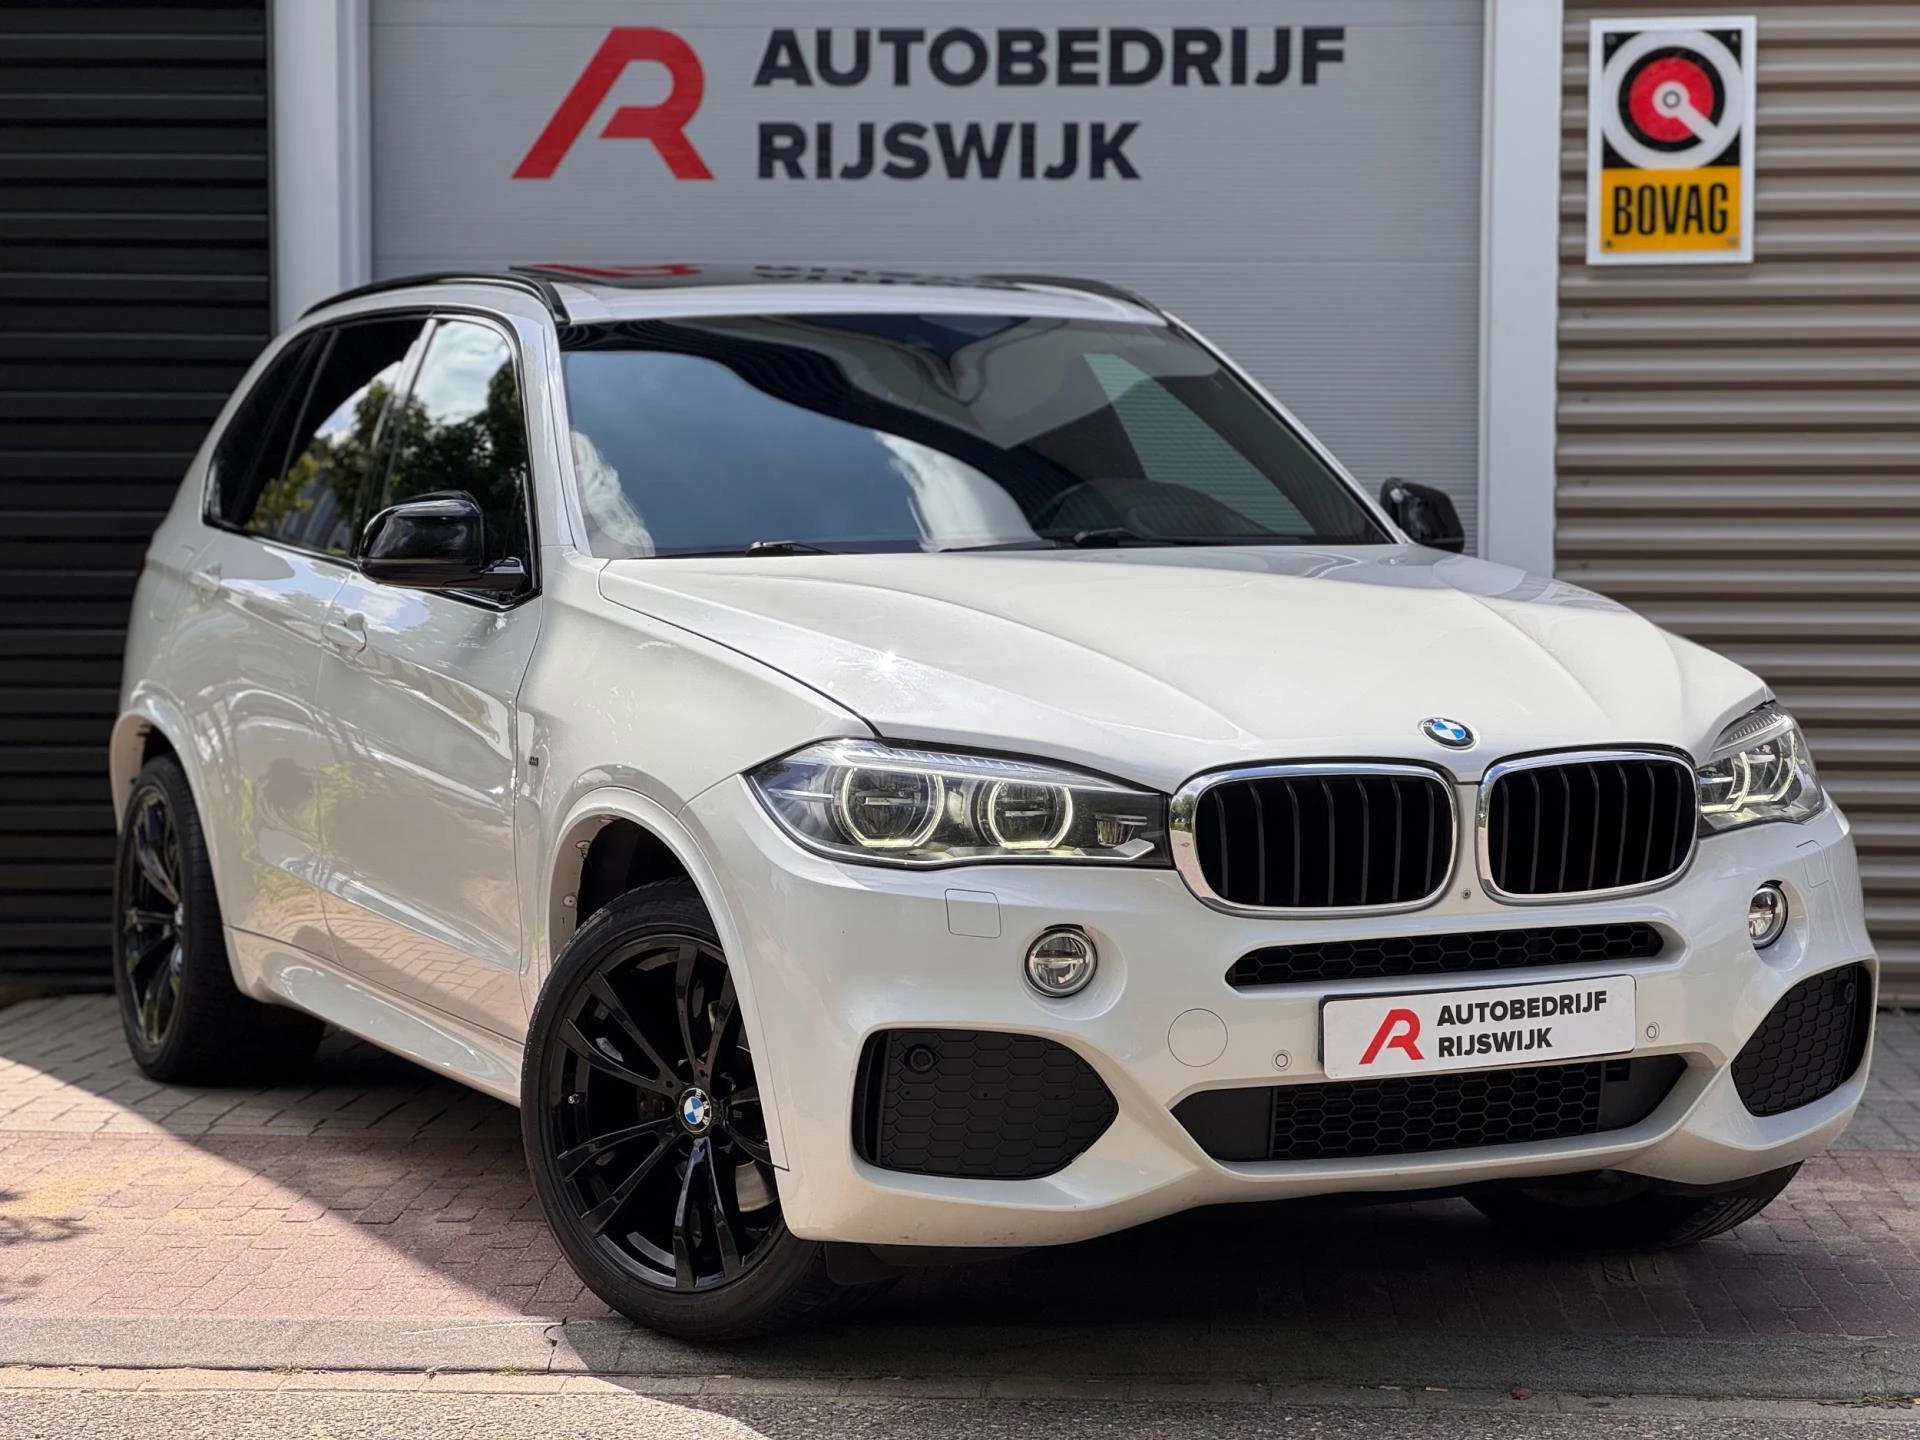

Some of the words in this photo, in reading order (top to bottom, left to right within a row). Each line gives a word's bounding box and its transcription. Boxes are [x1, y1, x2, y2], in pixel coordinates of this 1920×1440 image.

[753, 26, 1346, 88] AUTOBEDRIJF
[757, 121, 1142, 181] RIJSWIJK
[1612, 181, 1730, 237] BOVAG
[1436, 990, 1608, 1027] AUTOBEDRIJF
[1438, 1027, 1553, 1058] RIJSWIJK
